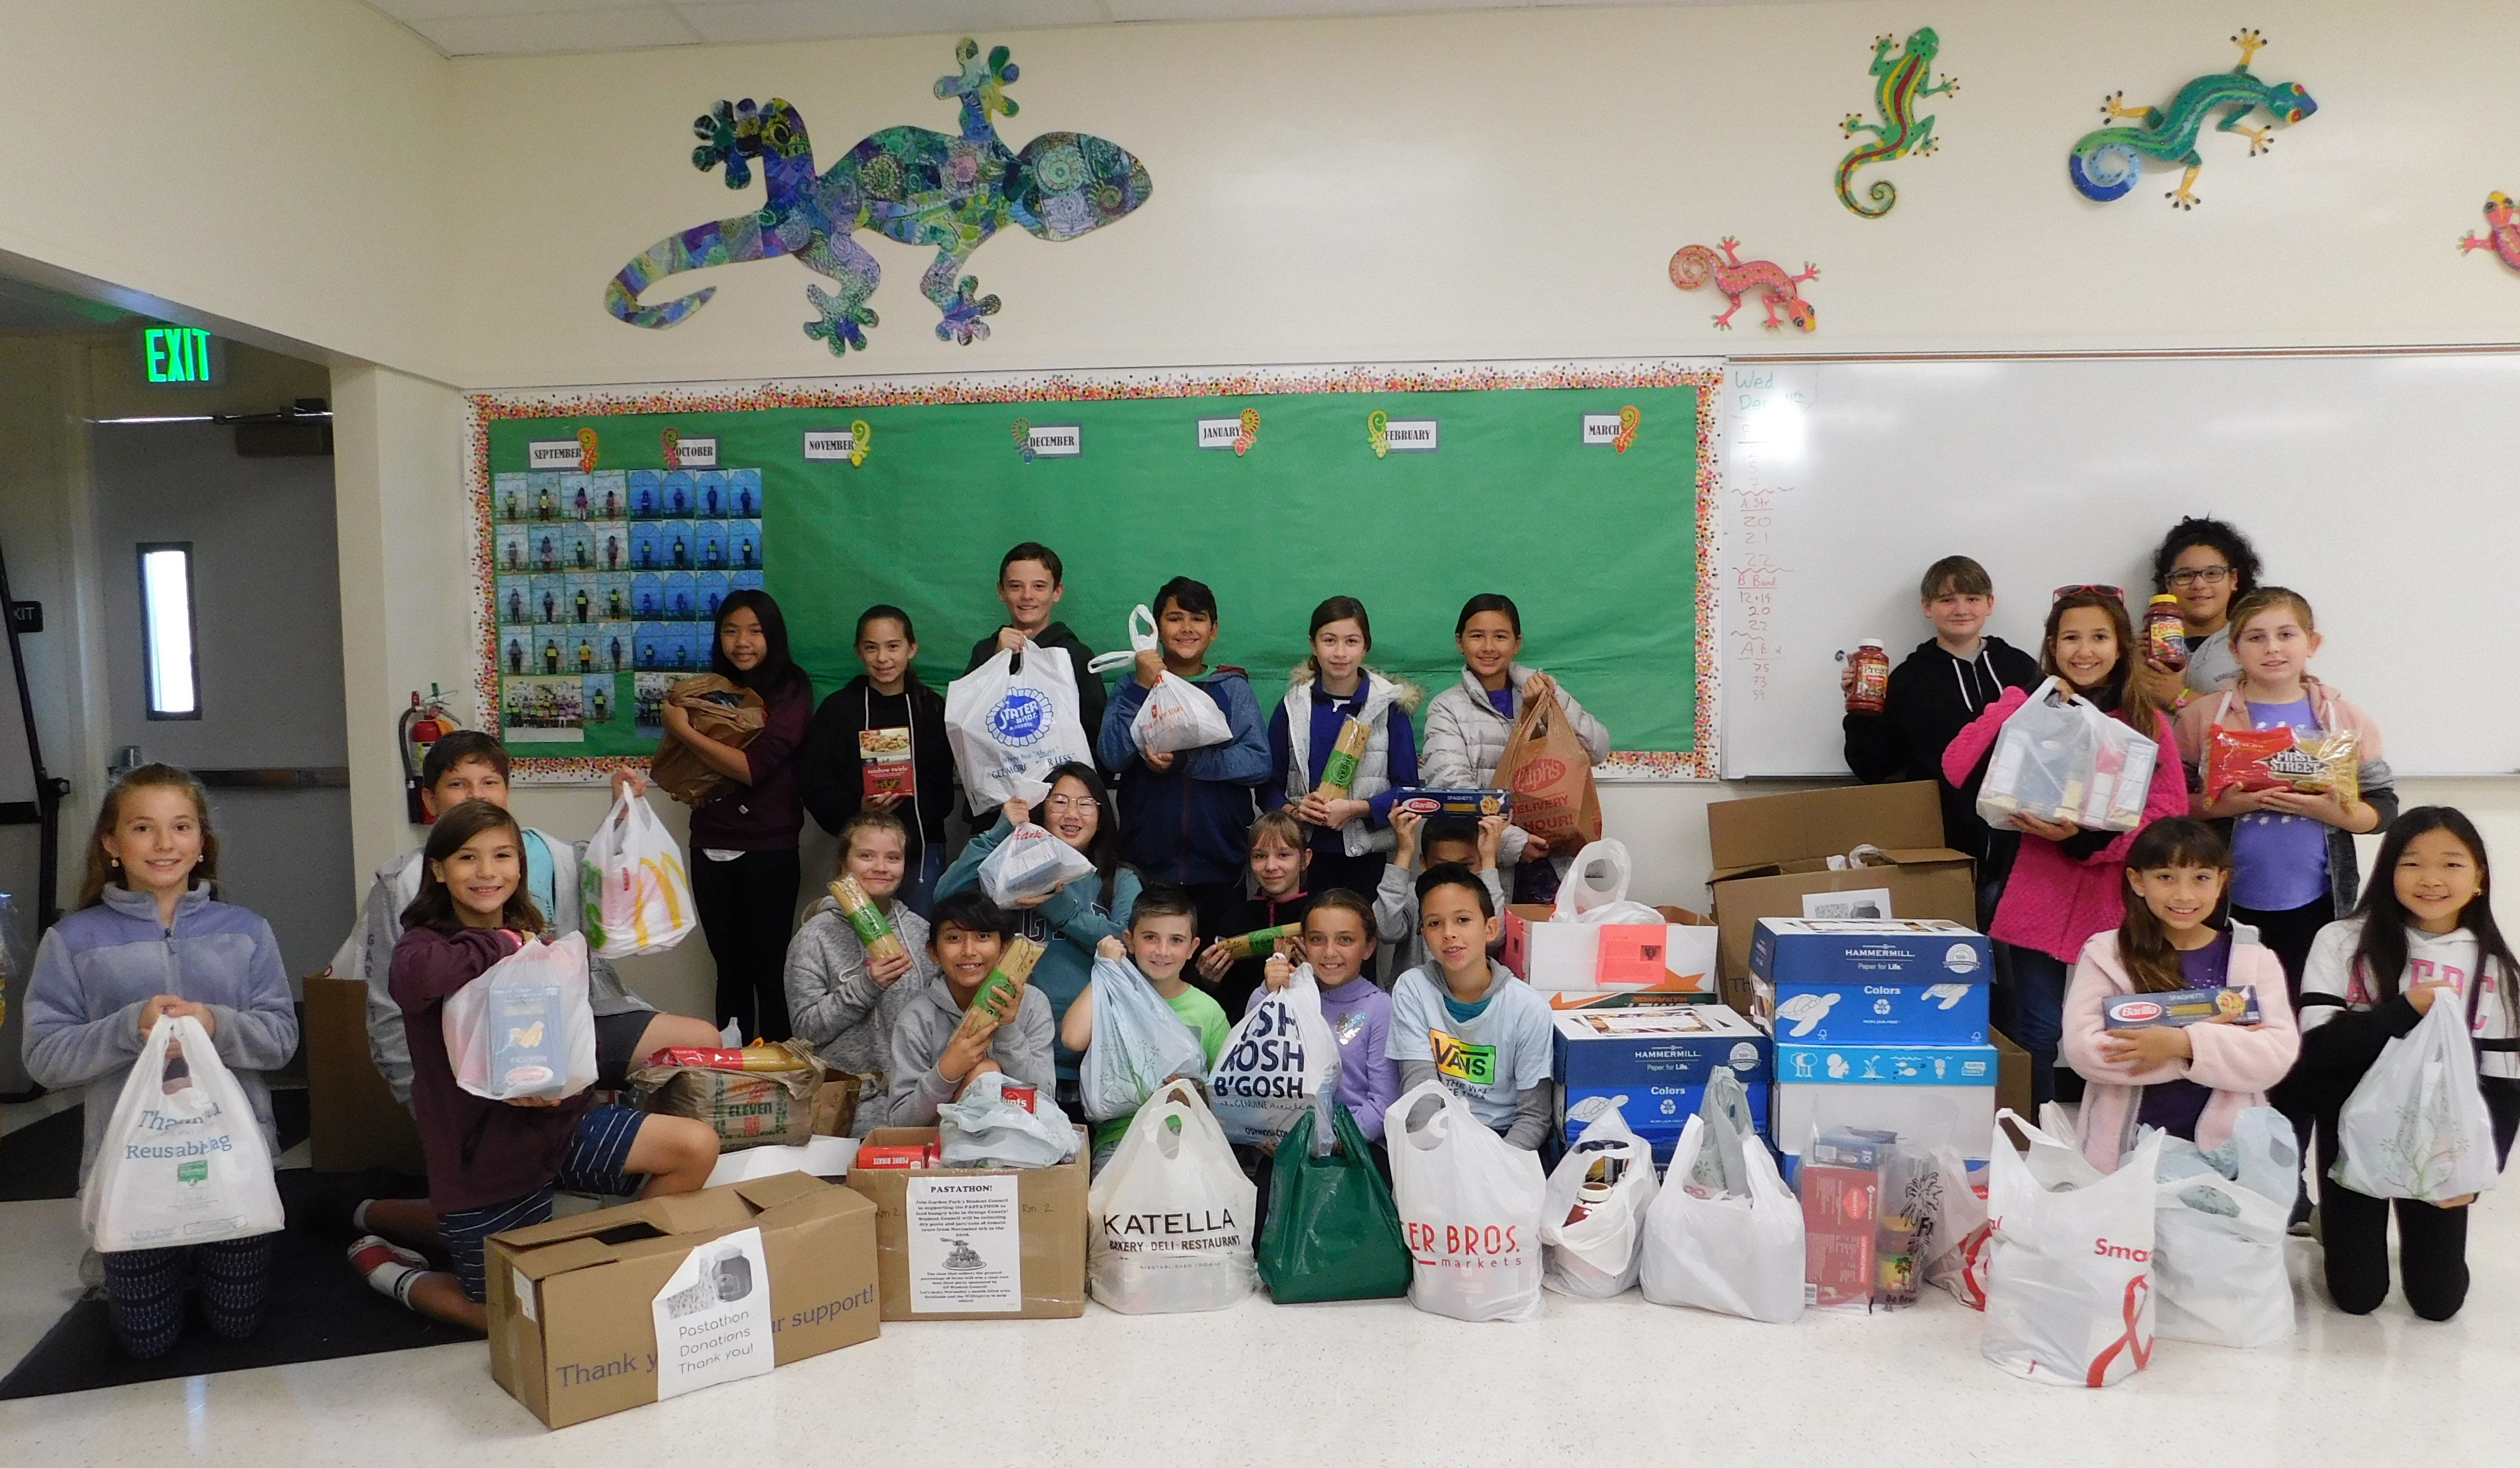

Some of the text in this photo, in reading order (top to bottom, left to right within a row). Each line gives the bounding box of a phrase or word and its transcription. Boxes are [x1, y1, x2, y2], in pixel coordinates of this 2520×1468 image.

[145, 327, 211, 382] EXIT
[1735, 370, 1774, 388] Wed
[1203, 426, 1241, 439] JANUARY
[1385, 429, 1431, 441] FEBRUARY
[1588, 425, 1620, 435] MARCH
[809, 439, 854, 450] NOVEMBER
[1030, 435, 1075, 447] DECEMBER
[534, 448, 581, 459] SEPTEMBER
[676, 446, 713, 456] OCTOBER
[1743, 516, 1771, 527] 20
[1745, 532, 1768, 544] 21
[14, 607, 35, 621] XIT
[1748, 606, 1771, 617] 20
[1748, 619, 1768, 631] 22
[999, 700, 1039, 730] STATER
[2277, 751, 2315, 762] FIRST
[2269, 759, 2321, 773] STREET
[1249, 937, 1274, 947] ORGA
[1864, 985, 1901, 994] Colors
[2122, 1006, 2157, 1016] Barilla
[1220, 1039, 1304, 1072] KOSH
[1434, 1037, 1489, 1076] VANS
[1214, 1076, 1303, 1099] B'GOSH
[1651, 1086, 1686, 1095] Colors
[1235, 1100, 1268, 1110] GENUINE
[1044, 1204, 1053, 1212] 2
[1102, 1208, 1236, 1235] KATELLA
[1109, 1235, 1241, 1253] BAKERY DELI RESTAURANT
[1446, 1224, 1520, 1256] BROS.
[1441, 1256, 1522, 1269] markets
[792, 1283, 873, 1326] support!
[679, 1311, 749, 1339] Pastathon
[680, 1328, 750, 1357] Donations
[678, 1353, 721, 1374] Thank
[725, 1343, 753, 1361] you!
[556, 1353, 637, 1388] Thank
